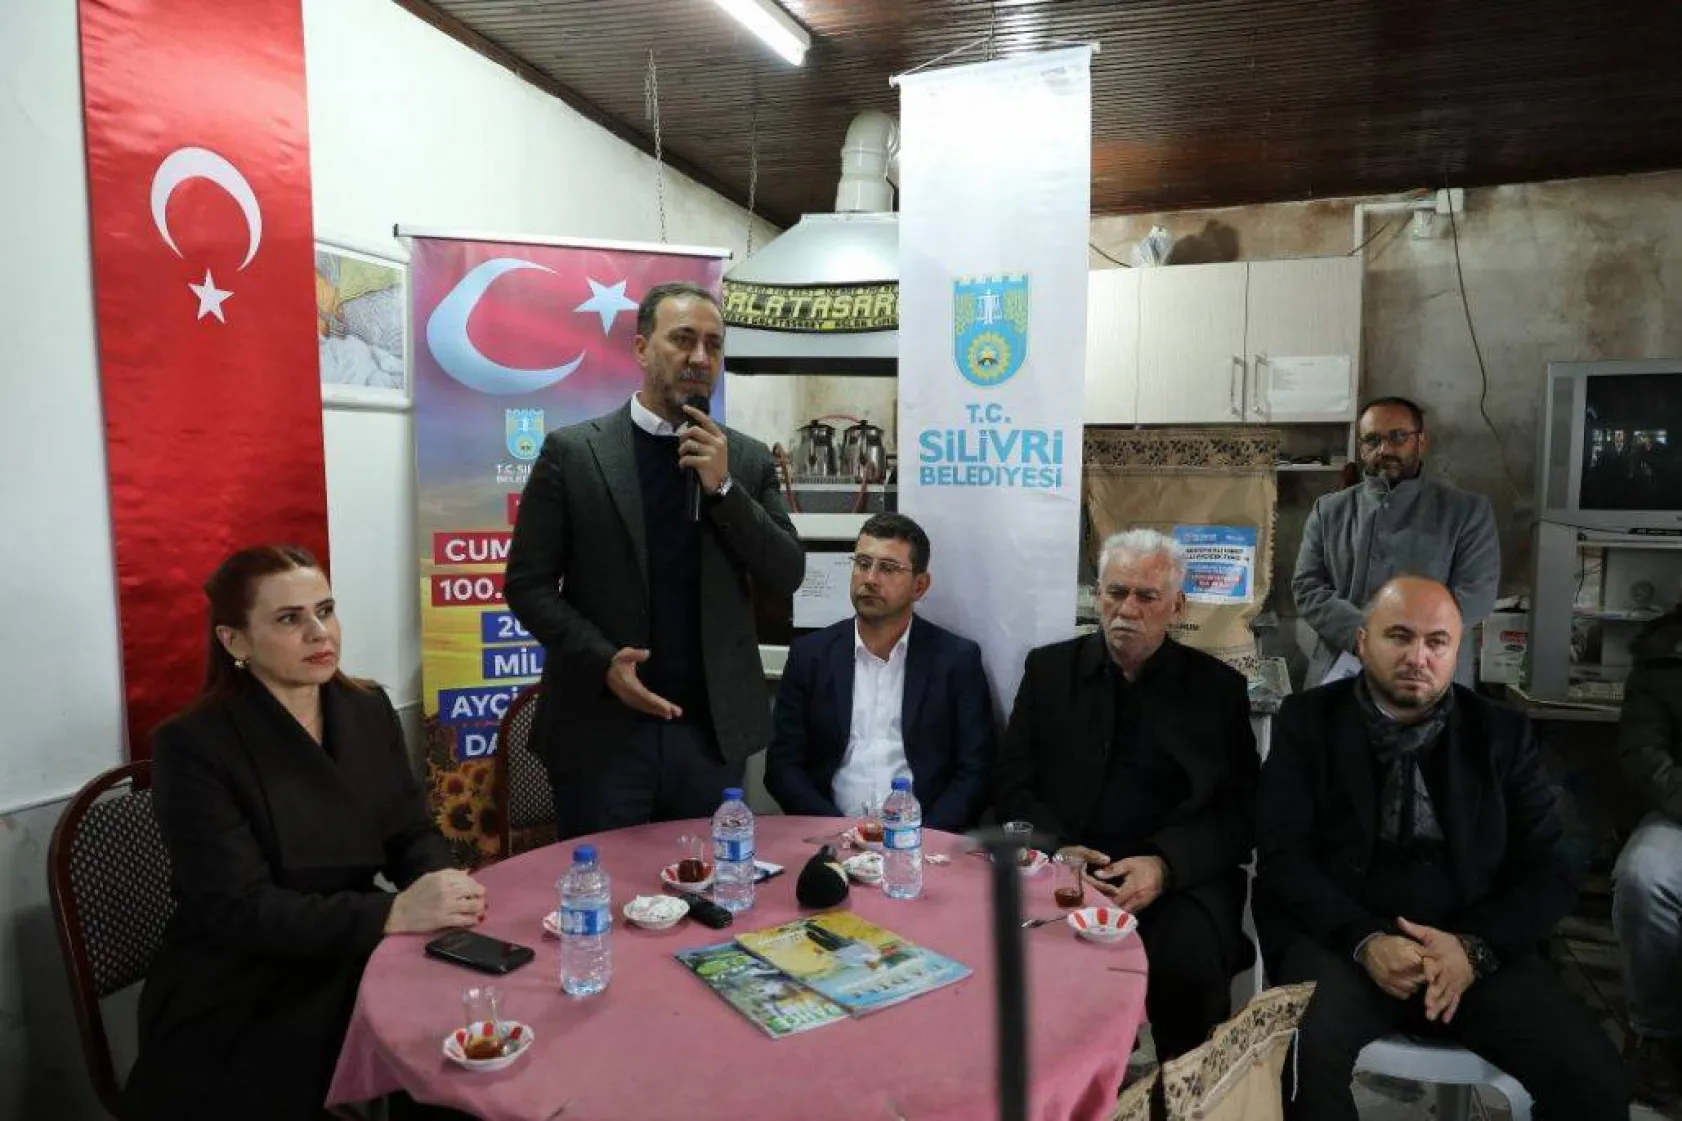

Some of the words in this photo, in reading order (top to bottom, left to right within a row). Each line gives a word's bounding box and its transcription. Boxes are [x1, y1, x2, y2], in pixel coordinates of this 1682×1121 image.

[966, 403, 1012, 424] T.C.
[440, 577, 503, 600] 100.
[494, 648, 543, 676] MİL
